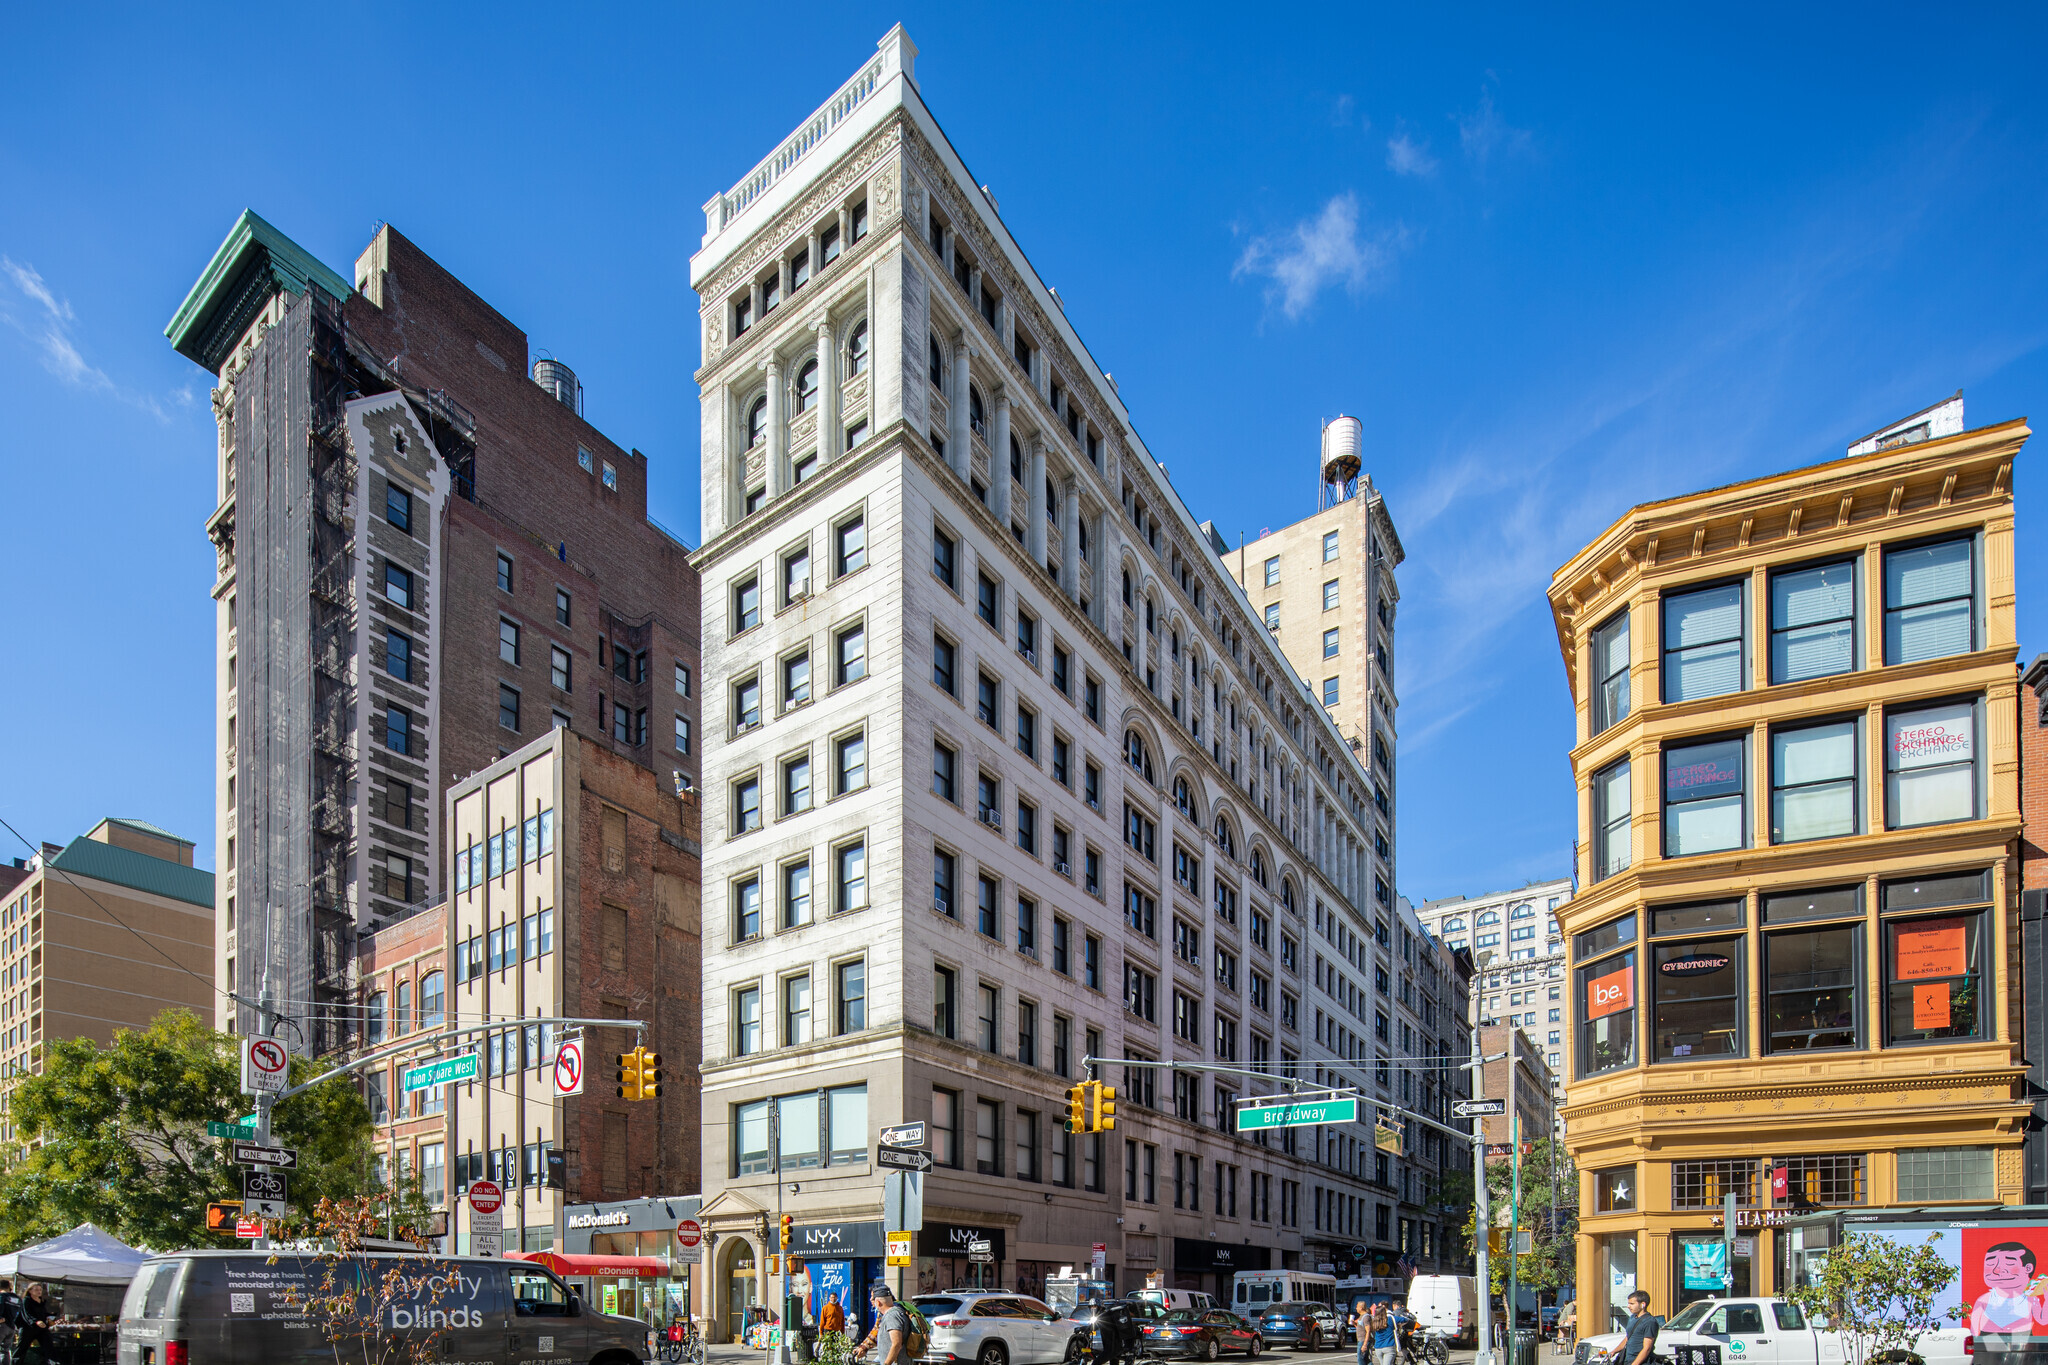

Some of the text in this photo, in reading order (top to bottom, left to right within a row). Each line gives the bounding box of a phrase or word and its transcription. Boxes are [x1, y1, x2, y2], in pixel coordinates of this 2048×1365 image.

[1895, 726, 1945, 742] STEREO
[1894, 733, 1965, 752] EXCHANGE
[1668, 762, 1717, 779] STEREO
[1668, 769, 1736, 789] EXCHANGE
[1596, 984, 1623, 1004] be.
[254, 1072, 283, 1081] EXCEPT
[407, 1073, 426, 1087] Union
[428, 1067, 453, 1084] Square
[455, 1059, 474, 1076] West
[257, 1080, 279, 1088] BIKES
[1460, 1102, 1501, 1113] ONE WAY
[1263, 1108, 1327, 1123] Broadway
[214, 1124, 220, 1135] E
[225, 1125, 237, 1136] 17
[885, 1129, 920, 1142] ONE WAY
[243, 1150, 288, 1163] ONE WAY
[882, 1151, 925, 1165] ONE WAY
[247, 1191, 284, 1200] BIKE LANE
[474, 1186, 483, 1194] DO
[568, 1210, 629, 1229] McDonald's
[1754, 1210, 1761, 1226] A
[805, 1227, 841, 1248] NYX
[890, 1233, 909, 1241] CYCLISTS
[949, 1228, 980, 1248] NYX
[1216, 1249, 1230, 1262] NYX
[247, 1271, 270, 1280] shop
[281, 1271, 306, 1279] home
[589, 1265, 640, 1276] McDonald's
[276, 1281, 306, 1289] shades
[821, 1270, 844, 1289] Epic
[391, 1304, 483, 1329] blinds
[283, 1321, 310, 1329] blinds
[1728, 1353, 1747, 1361] 6049
